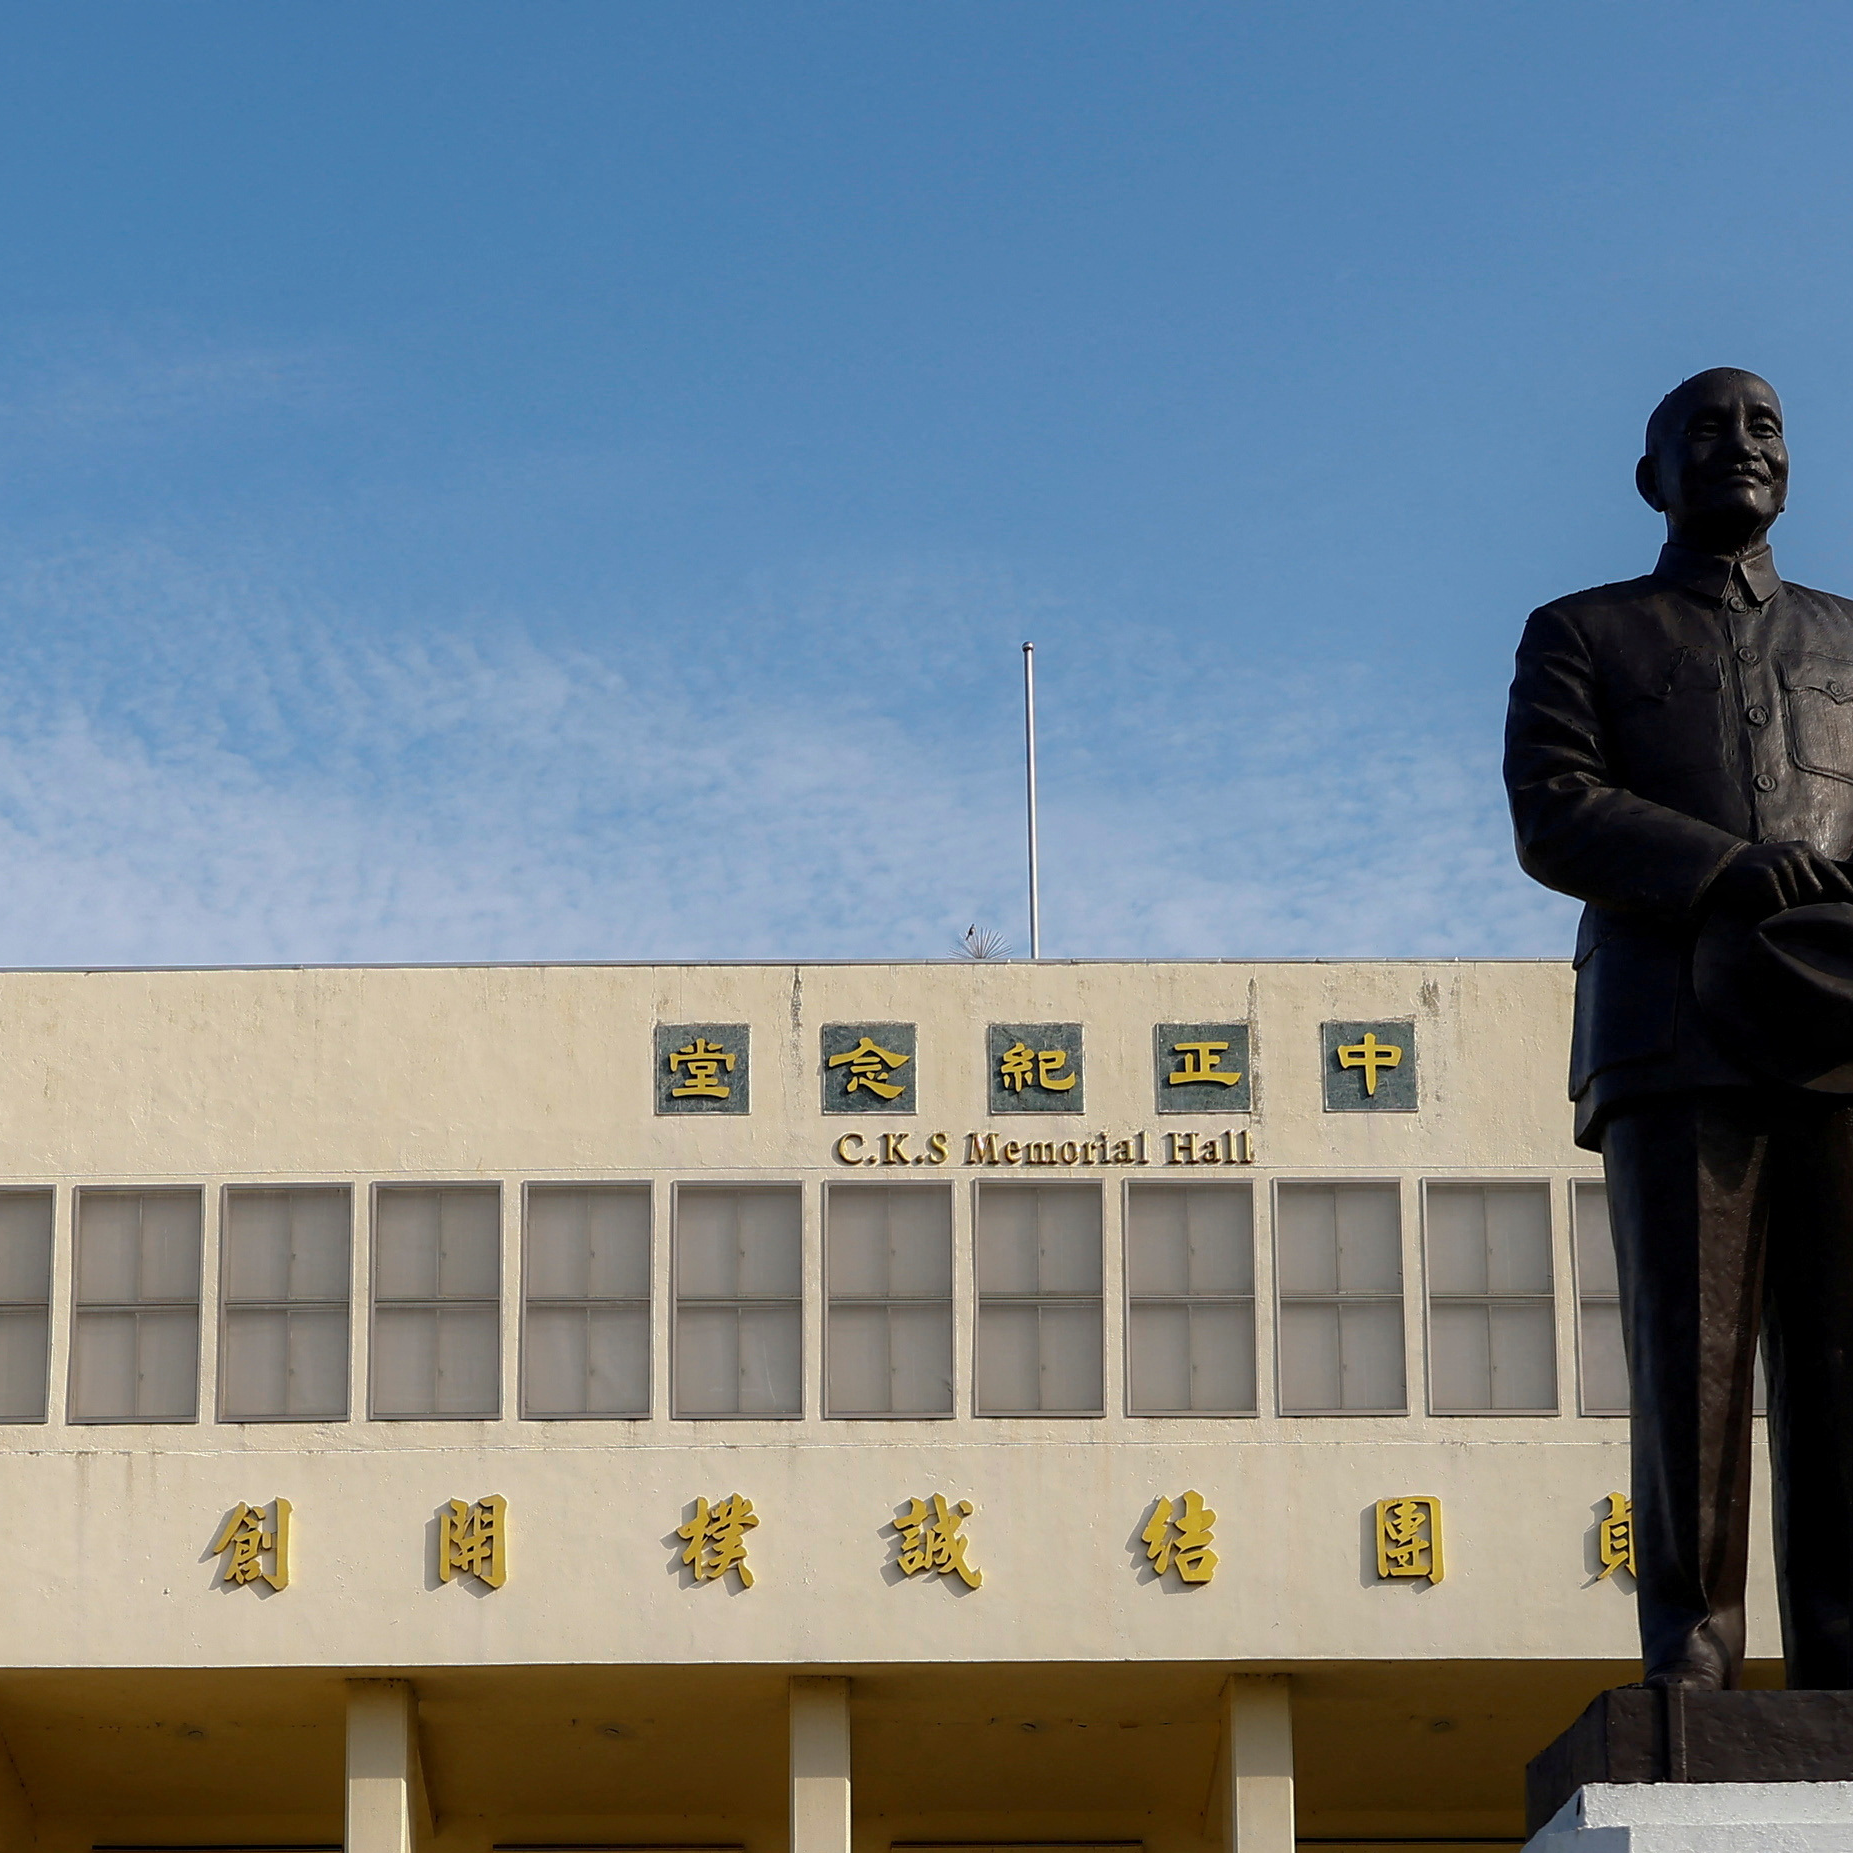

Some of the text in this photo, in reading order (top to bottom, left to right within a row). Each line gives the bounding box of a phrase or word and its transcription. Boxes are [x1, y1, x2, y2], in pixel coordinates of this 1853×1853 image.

[667, 1031, 1405, 1101] 中正紀念堂
[835, 1128, 1256, 1166] C.K.S Memorial Hall
